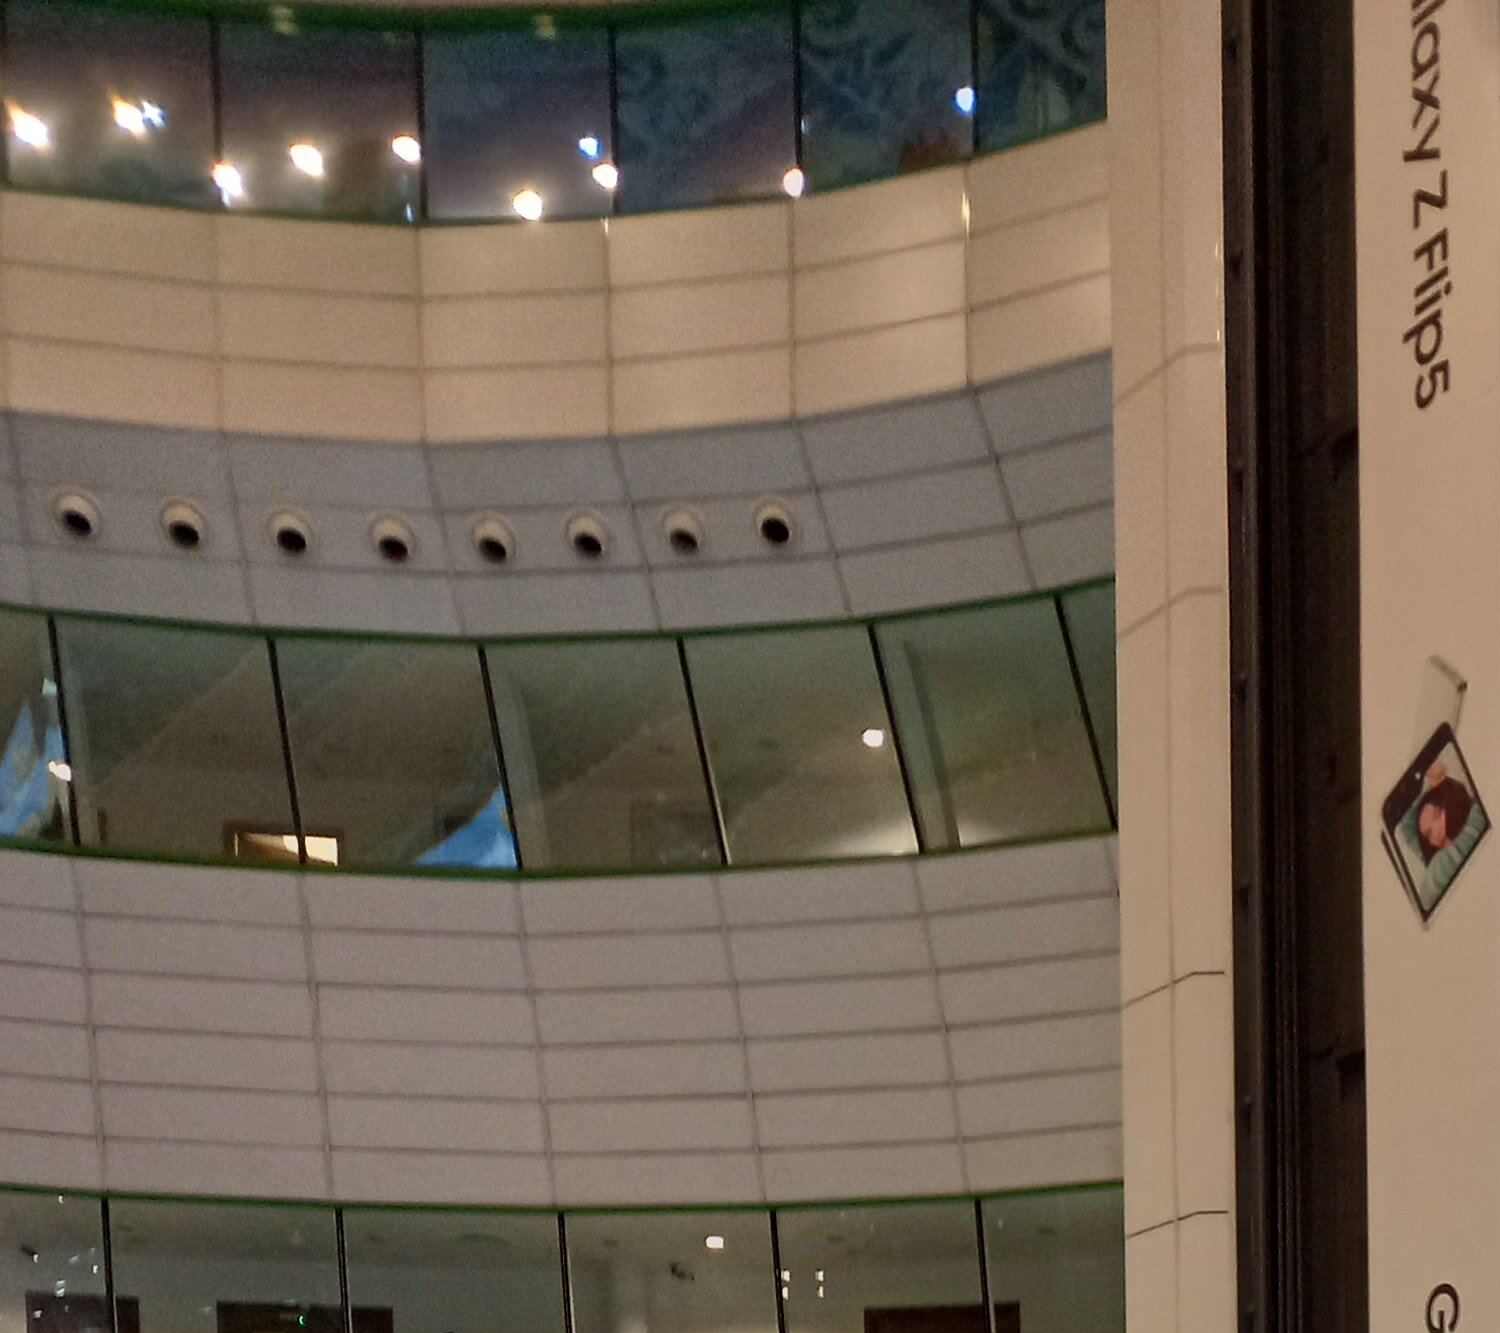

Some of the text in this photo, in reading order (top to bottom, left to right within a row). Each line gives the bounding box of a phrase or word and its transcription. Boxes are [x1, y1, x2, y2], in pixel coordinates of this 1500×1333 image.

[1402, 0, 1453, 410] laxy Z Flip5
